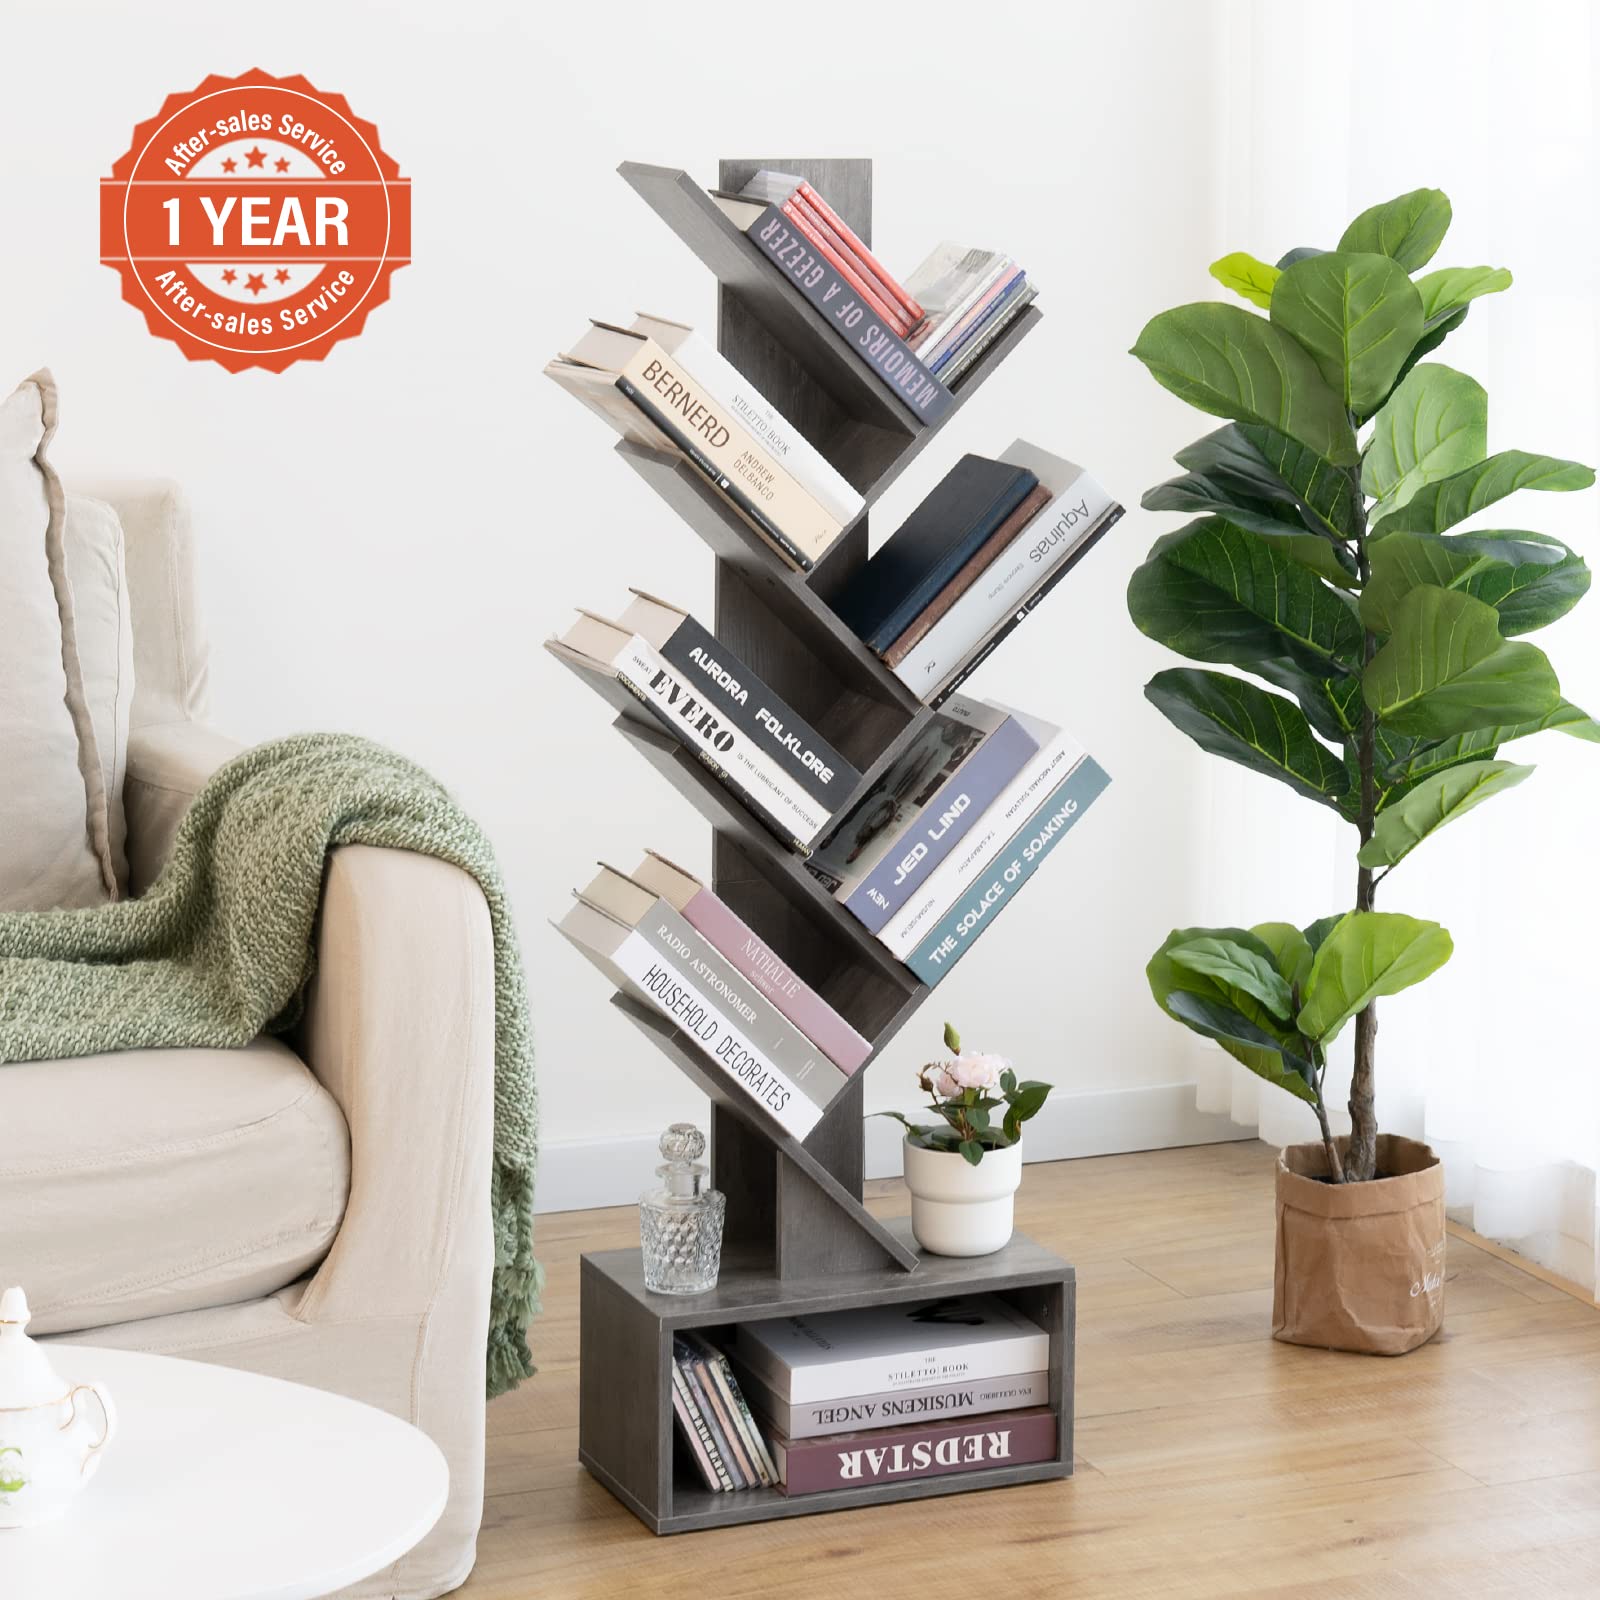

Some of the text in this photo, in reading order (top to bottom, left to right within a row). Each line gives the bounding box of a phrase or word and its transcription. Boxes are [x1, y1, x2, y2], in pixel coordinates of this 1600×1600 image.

[759, 217, 825, 290] GEEZER
[822, 281, 842, 303] A
[836, 304, 861, 329] OF
[860, 324, 939, 410] MEMOIRS
[641, 359, 731, 448] BERNERD
[731, 394, 768, 431] STILETTO
[767, 427, 792, 456] BOOK
[733, 459, 774, 501] DELBANCO
[740, 450, 776, 485] ANDREW
[1029, 499, 1090, 563] Aquinas
[650, 669, 735, 752] EVERO
[689, 647, 834, 784] AURORA FOLKLORE
[893, 793, 971, 886] JED LIND
[866, 888, 889, 910] NEW
[928, 799, 1078, 965] THE SOLACE OF SOAKING
[656, 924, 758, 1024] RADIO ASTRONOMER
[741, 938, 800, 999] NATHALIE
[642, 963, 791, 1112] HOUSEHOLD DECORATES
[887, 1367, 938, 1382] STILETTO
[942, 1363, 969, 1376] BOOK
[812, 1403, 876, 1425] ANGEL
[881, 1391, 974, 1418] MUSIKENS
[839, 1429, 1011, 1480] REDSTAR
